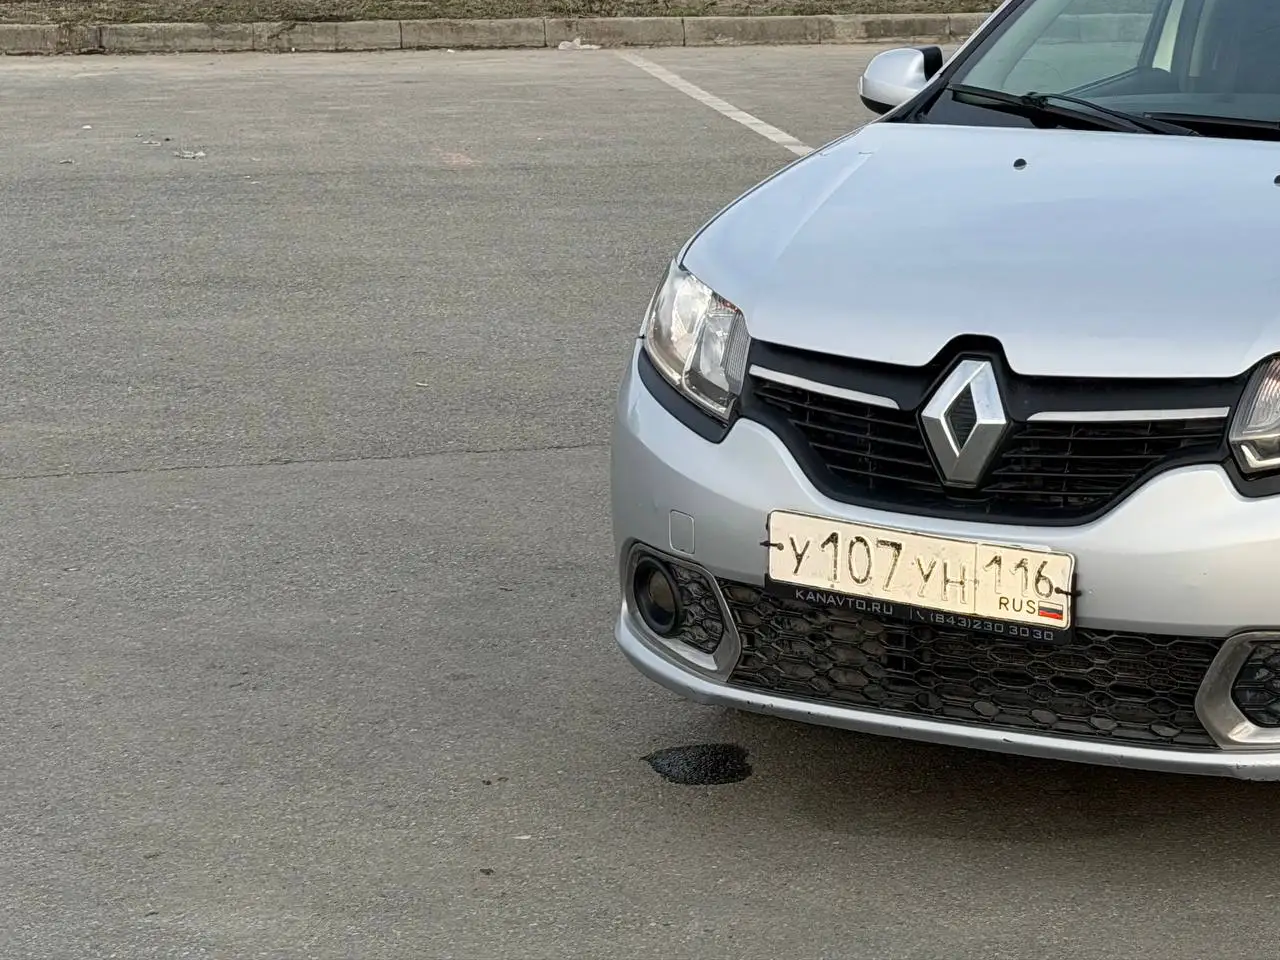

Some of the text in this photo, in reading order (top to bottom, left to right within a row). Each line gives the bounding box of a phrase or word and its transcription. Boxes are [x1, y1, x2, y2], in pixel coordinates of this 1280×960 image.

[983, 554, 1053, 599] 116
[795, 588, 893, 616] KANAVTO.RU
[999, 595, 1036, 615] RUS
